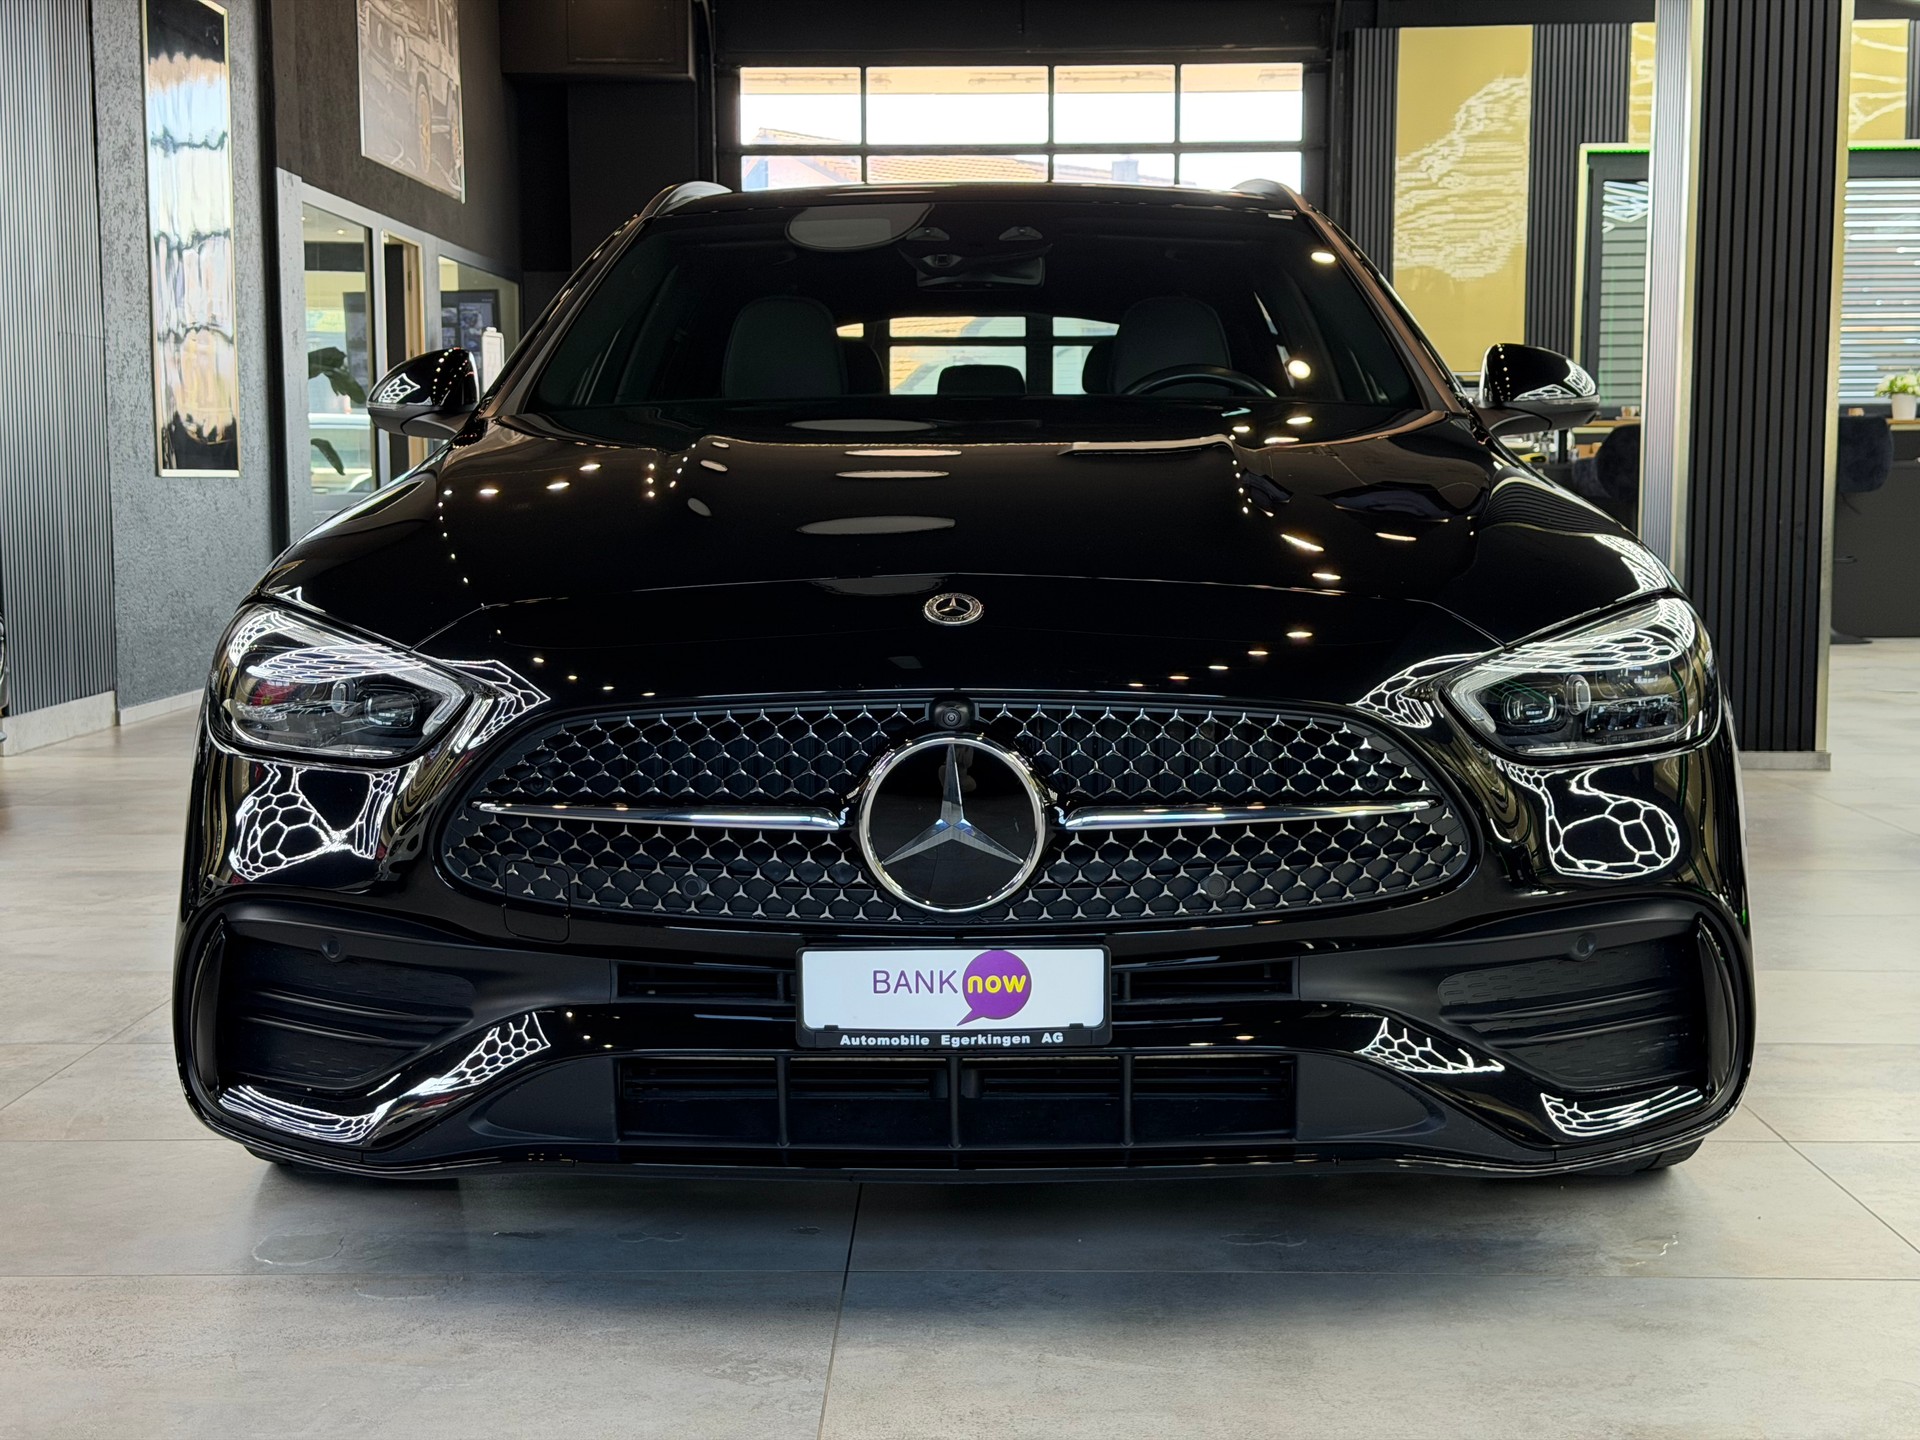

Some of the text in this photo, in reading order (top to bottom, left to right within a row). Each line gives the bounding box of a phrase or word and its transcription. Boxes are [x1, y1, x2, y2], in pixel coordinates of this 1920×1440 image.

[873, 970, 1027, 994] BANK now
[840, 1032, 1064, 1048] Automobile Egerkingen AG
